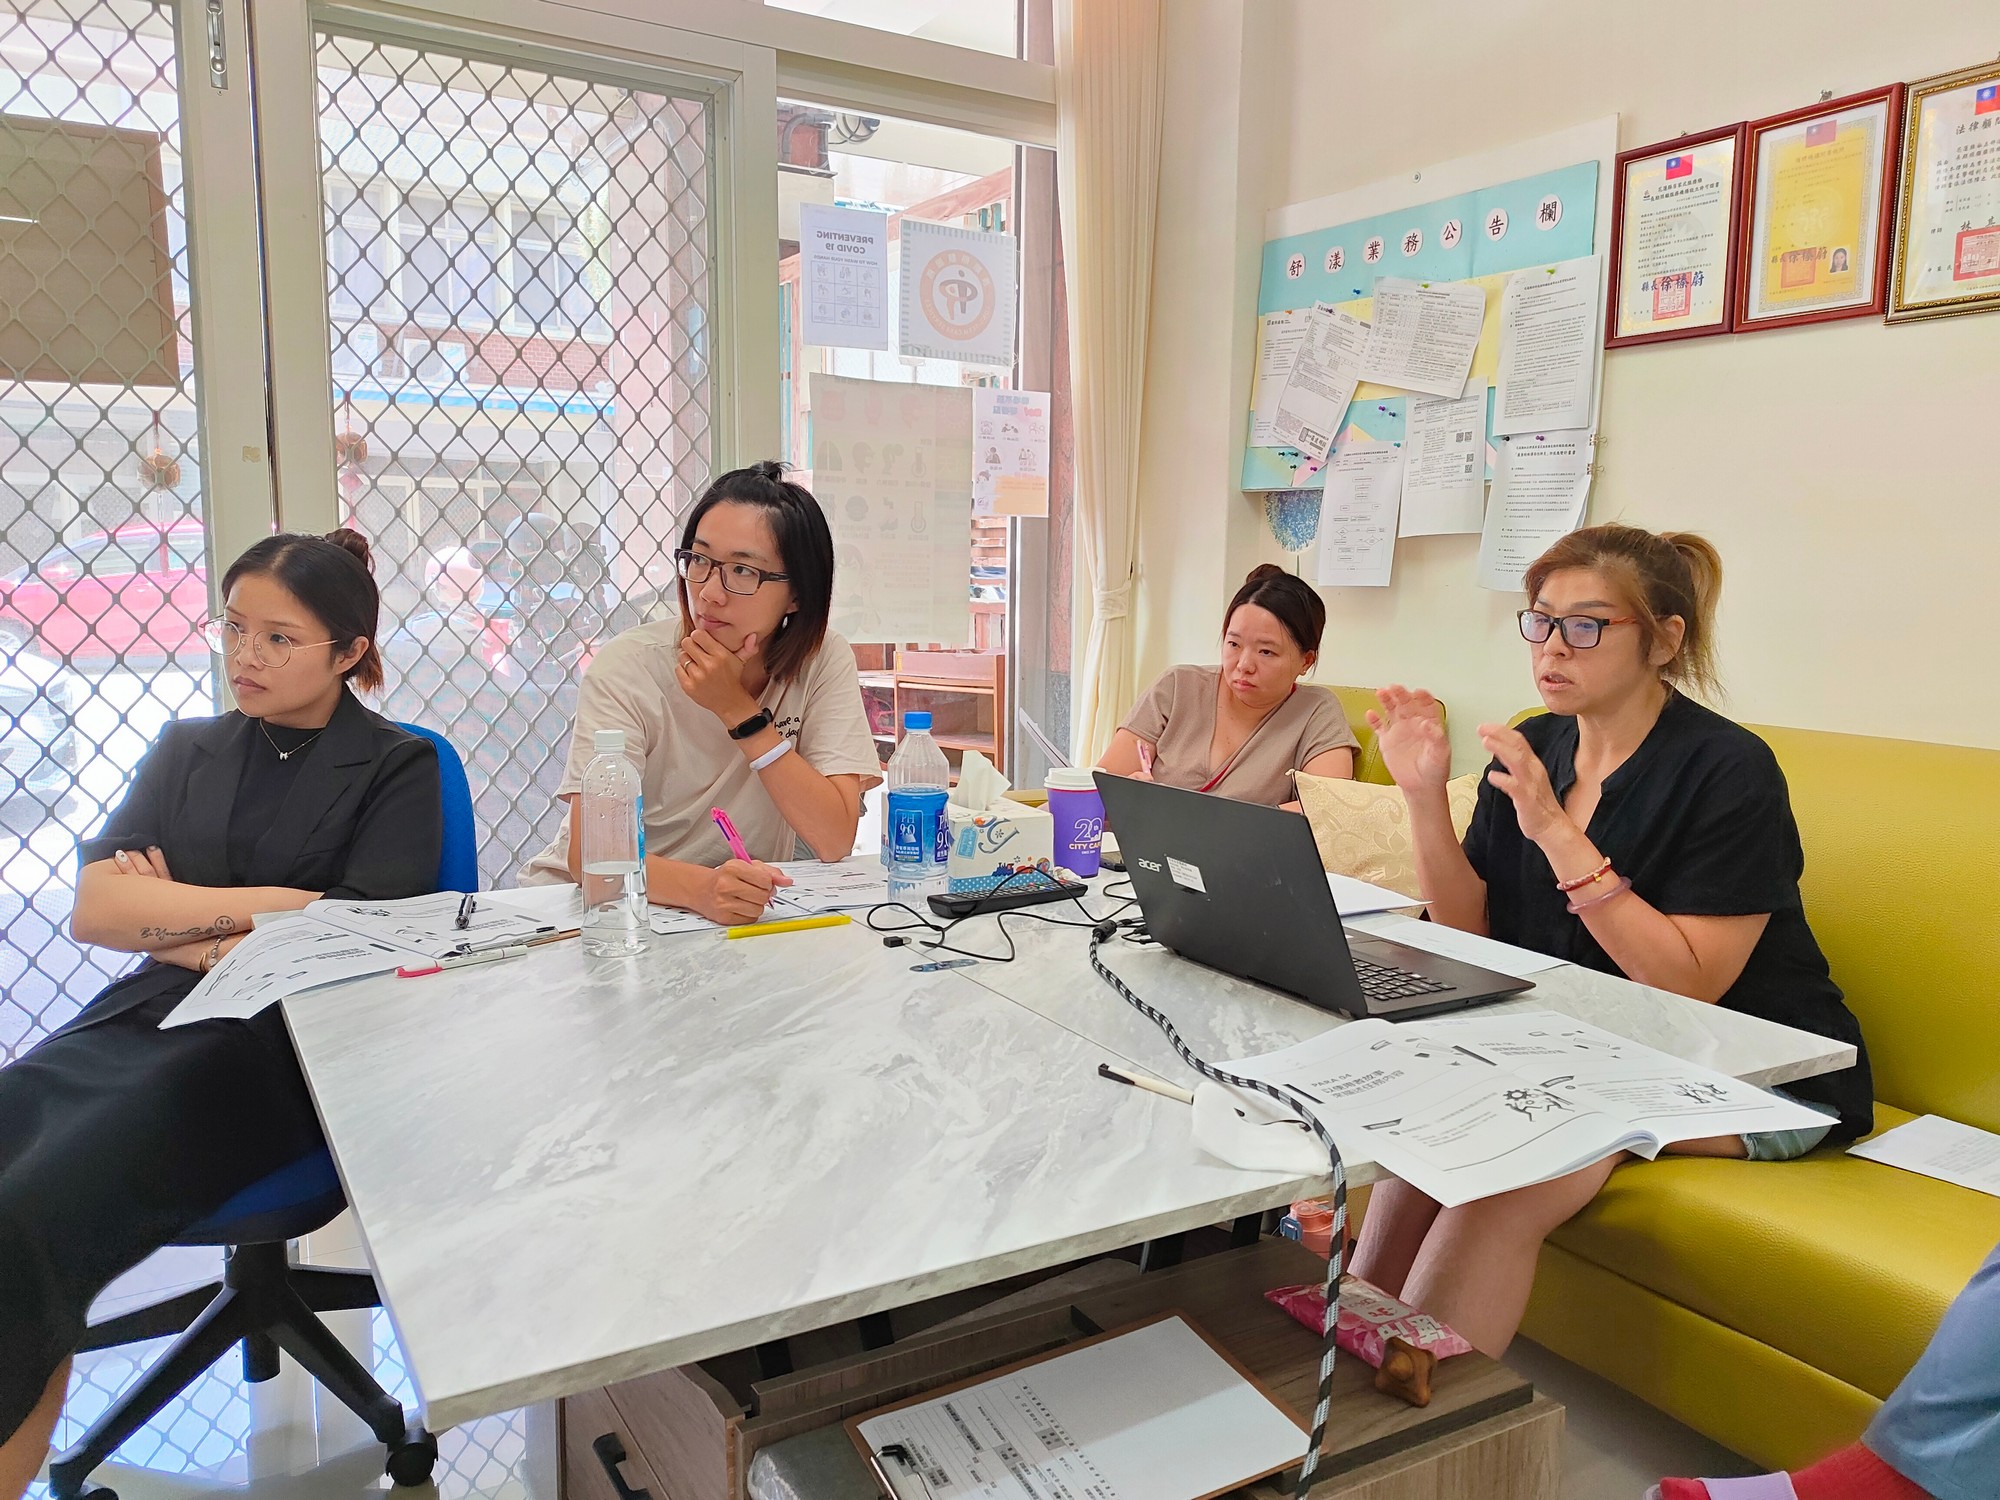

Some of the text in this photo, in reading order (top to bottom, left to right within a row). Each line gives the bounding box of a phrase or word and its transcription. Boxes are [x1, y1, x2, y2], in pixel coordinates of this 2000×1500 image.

[785, 728, 800, 739] day
[901, 812, 915, 824] PH
[1138, 857, 1162, 873] acer
[1311, 1078, 1338, 1088] PARA
